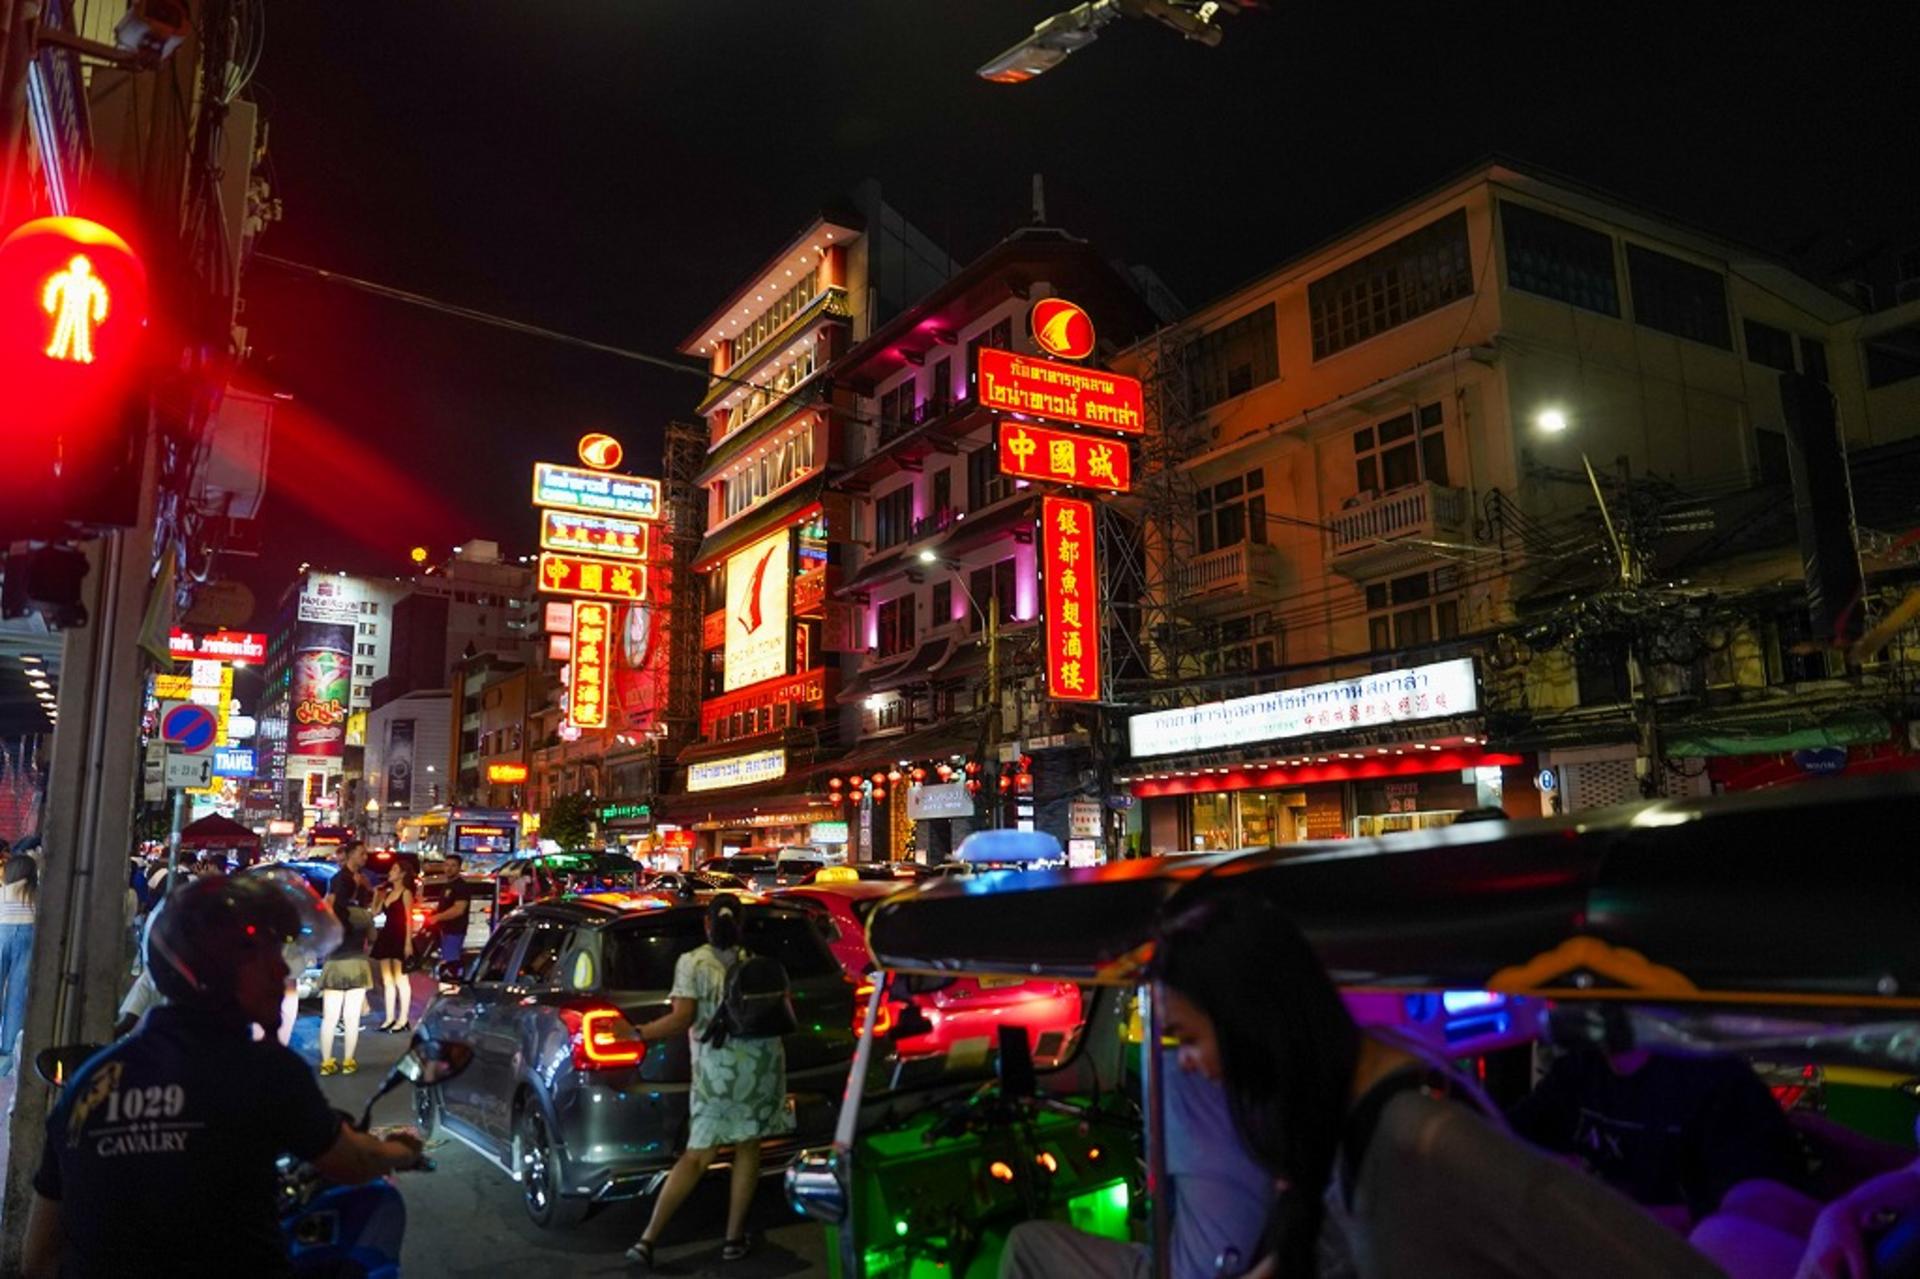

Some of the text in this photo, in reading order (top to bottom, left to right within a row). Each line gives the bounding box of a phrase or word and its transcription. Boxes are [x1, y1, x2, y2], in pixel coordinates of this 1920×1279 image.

[985, 372, 1139, 427] ไชน่าทาวน์ สกาล่า
[1008, 428, 1119, 486] 中國城
[546, 558, 637, 598] 中國城
[1057, 508, 1085, 691] 銀都魚翅酒樓
[215, 752, 254, 772] TRAVEL
[105, 1084, 185, 1122] 1029
[97, 1131, 188, 1157] CAVALRY
